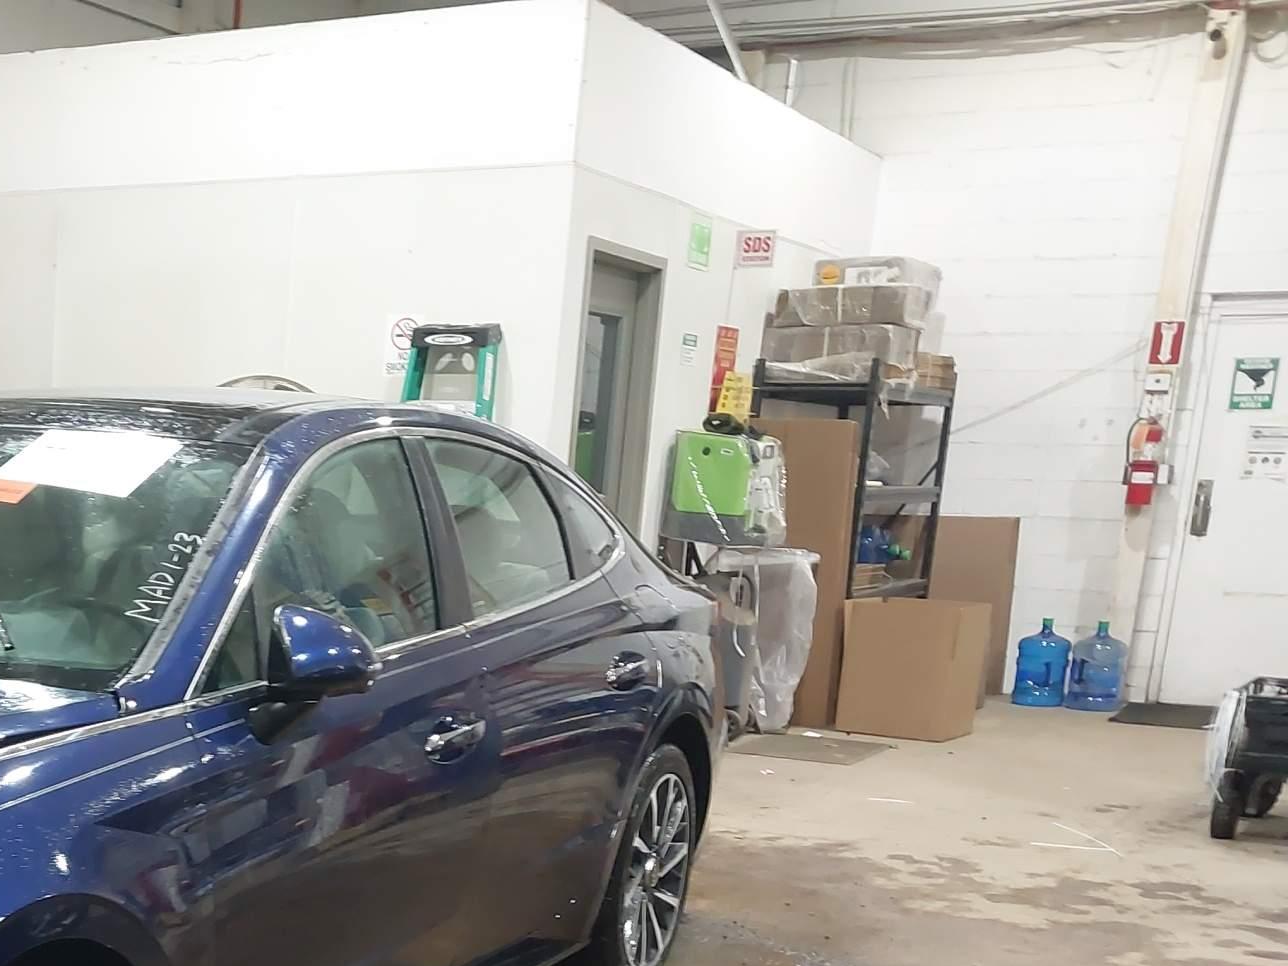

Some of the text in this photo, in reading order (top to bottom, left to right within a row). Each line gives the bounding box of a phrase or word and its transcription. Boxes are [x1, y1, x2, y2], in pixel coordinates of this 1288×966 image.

[743, 236, 772, 253] SDS
[123, 532, 204, 623] MAD 1-23
